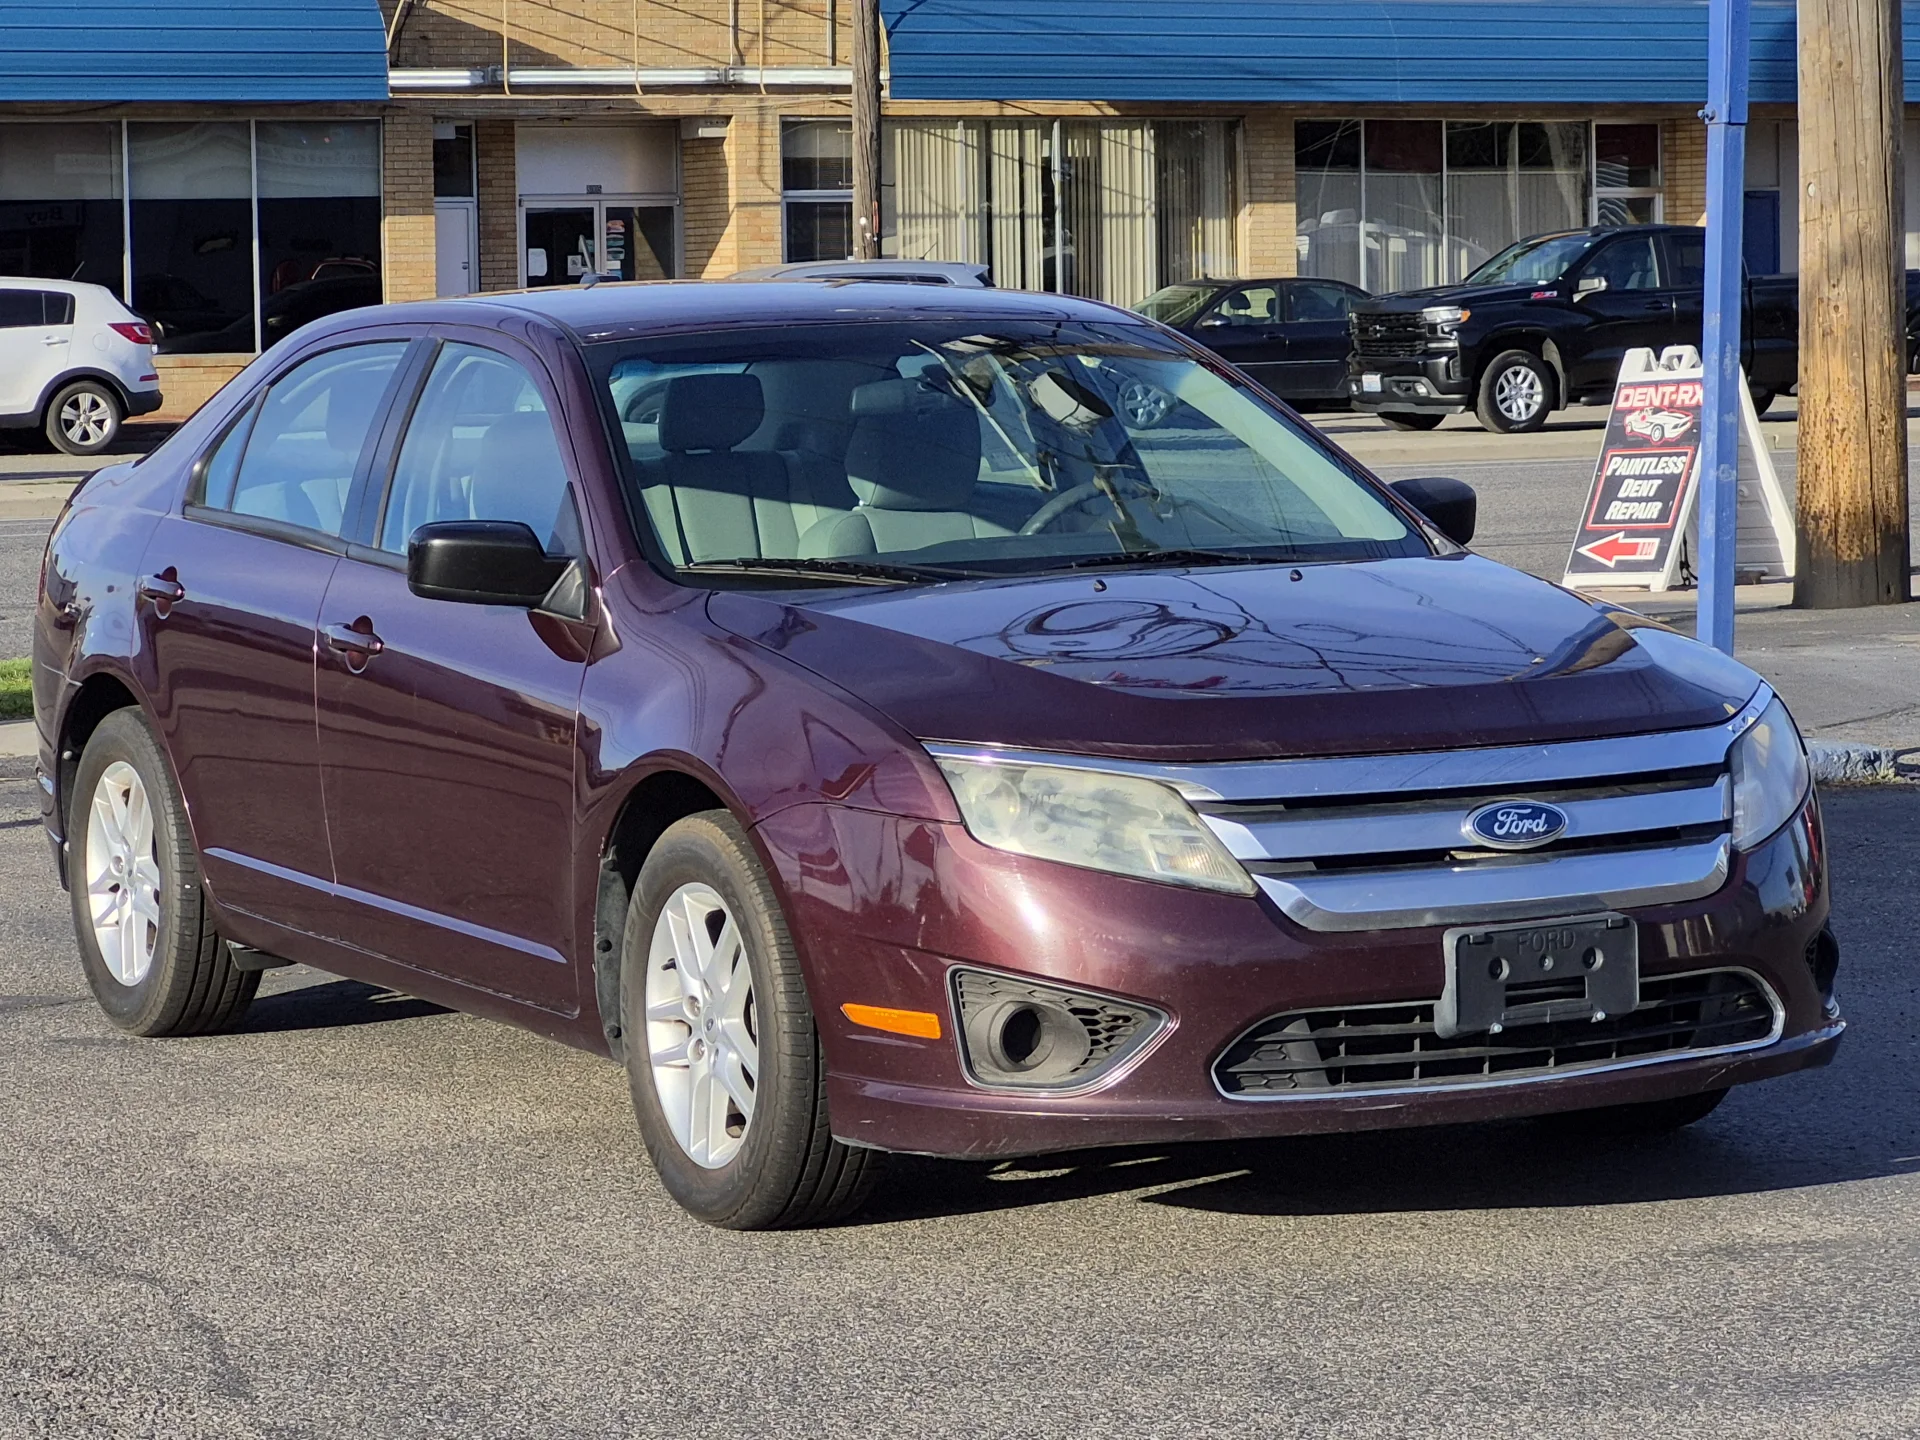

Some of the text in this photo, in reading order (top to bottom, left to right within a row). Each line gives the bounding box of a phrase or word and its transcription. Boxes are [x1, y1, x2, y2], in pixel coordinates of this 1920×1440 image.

[1605, 456, 1686, 477] PAINTLESS
[1617, 479, 1663, 498] DENT
[1604, 501, 1663, 520] REPAIR
[1493, 808, 1548, 835] Ford
[1517, 929, 1577, 954] FORD
